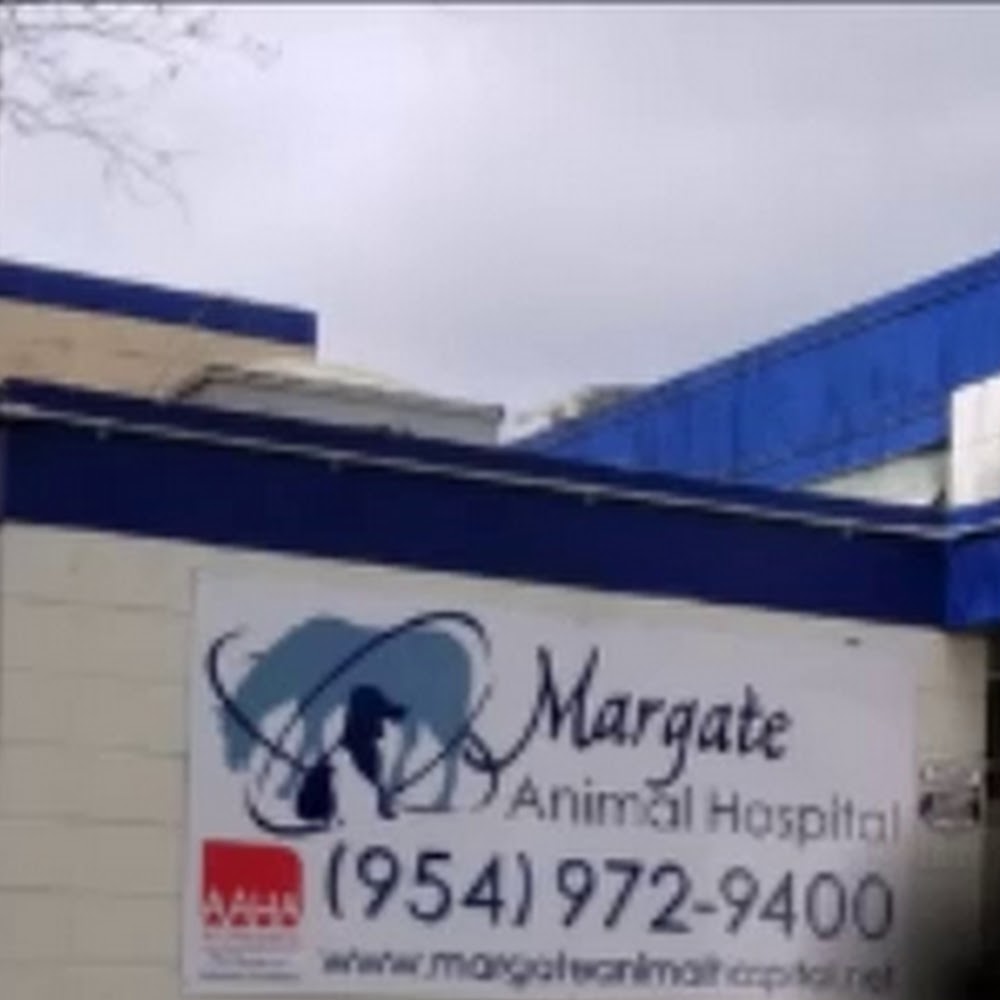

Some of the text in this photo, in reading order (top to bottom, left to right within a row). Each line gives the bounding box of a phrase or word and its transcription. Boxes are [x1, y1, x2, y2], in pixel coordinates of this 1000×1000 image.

[512, 645, 794, 787] Margate
[507, 775, 903, 848] Animal Hospital
[325, 841, 895, 942] (954) 972-9400
